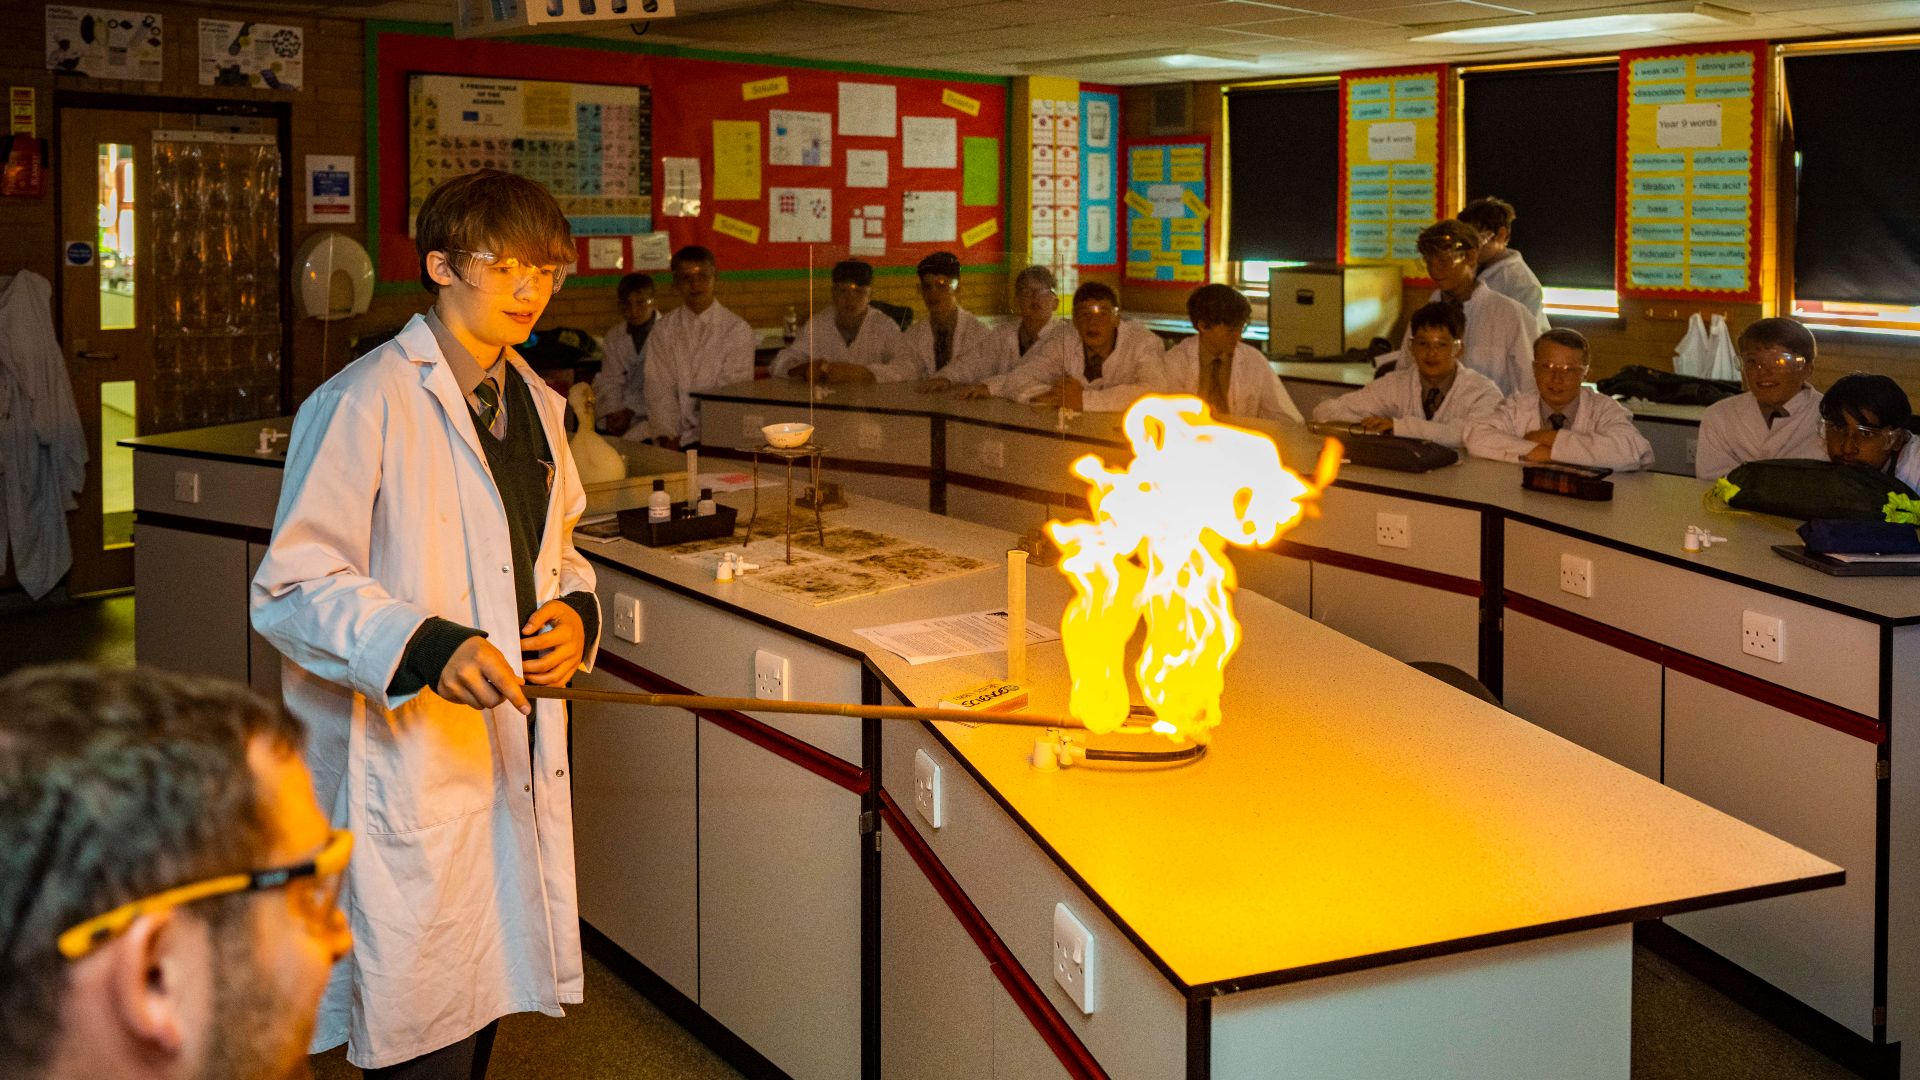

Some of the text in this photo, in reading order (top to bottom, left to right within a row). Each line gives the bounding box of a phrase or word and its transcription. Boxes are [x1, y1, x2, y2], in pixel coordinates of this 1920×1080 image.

[1662, 66, 1679, 74] acid
[1702, 61, 1745, 71] strong acid
[1635, 88, 1685, 97] dissociation
[1659, 118, 1718, 129] Year 9 words
[1728, 156, 1746, 164] acid
[1642, 183, 1676, 191] titration
[1699, 182, 1741, 190] nitric acid
[1647, 205, 1668, 213] base
[1639, 250, 1676, 258] indicator
